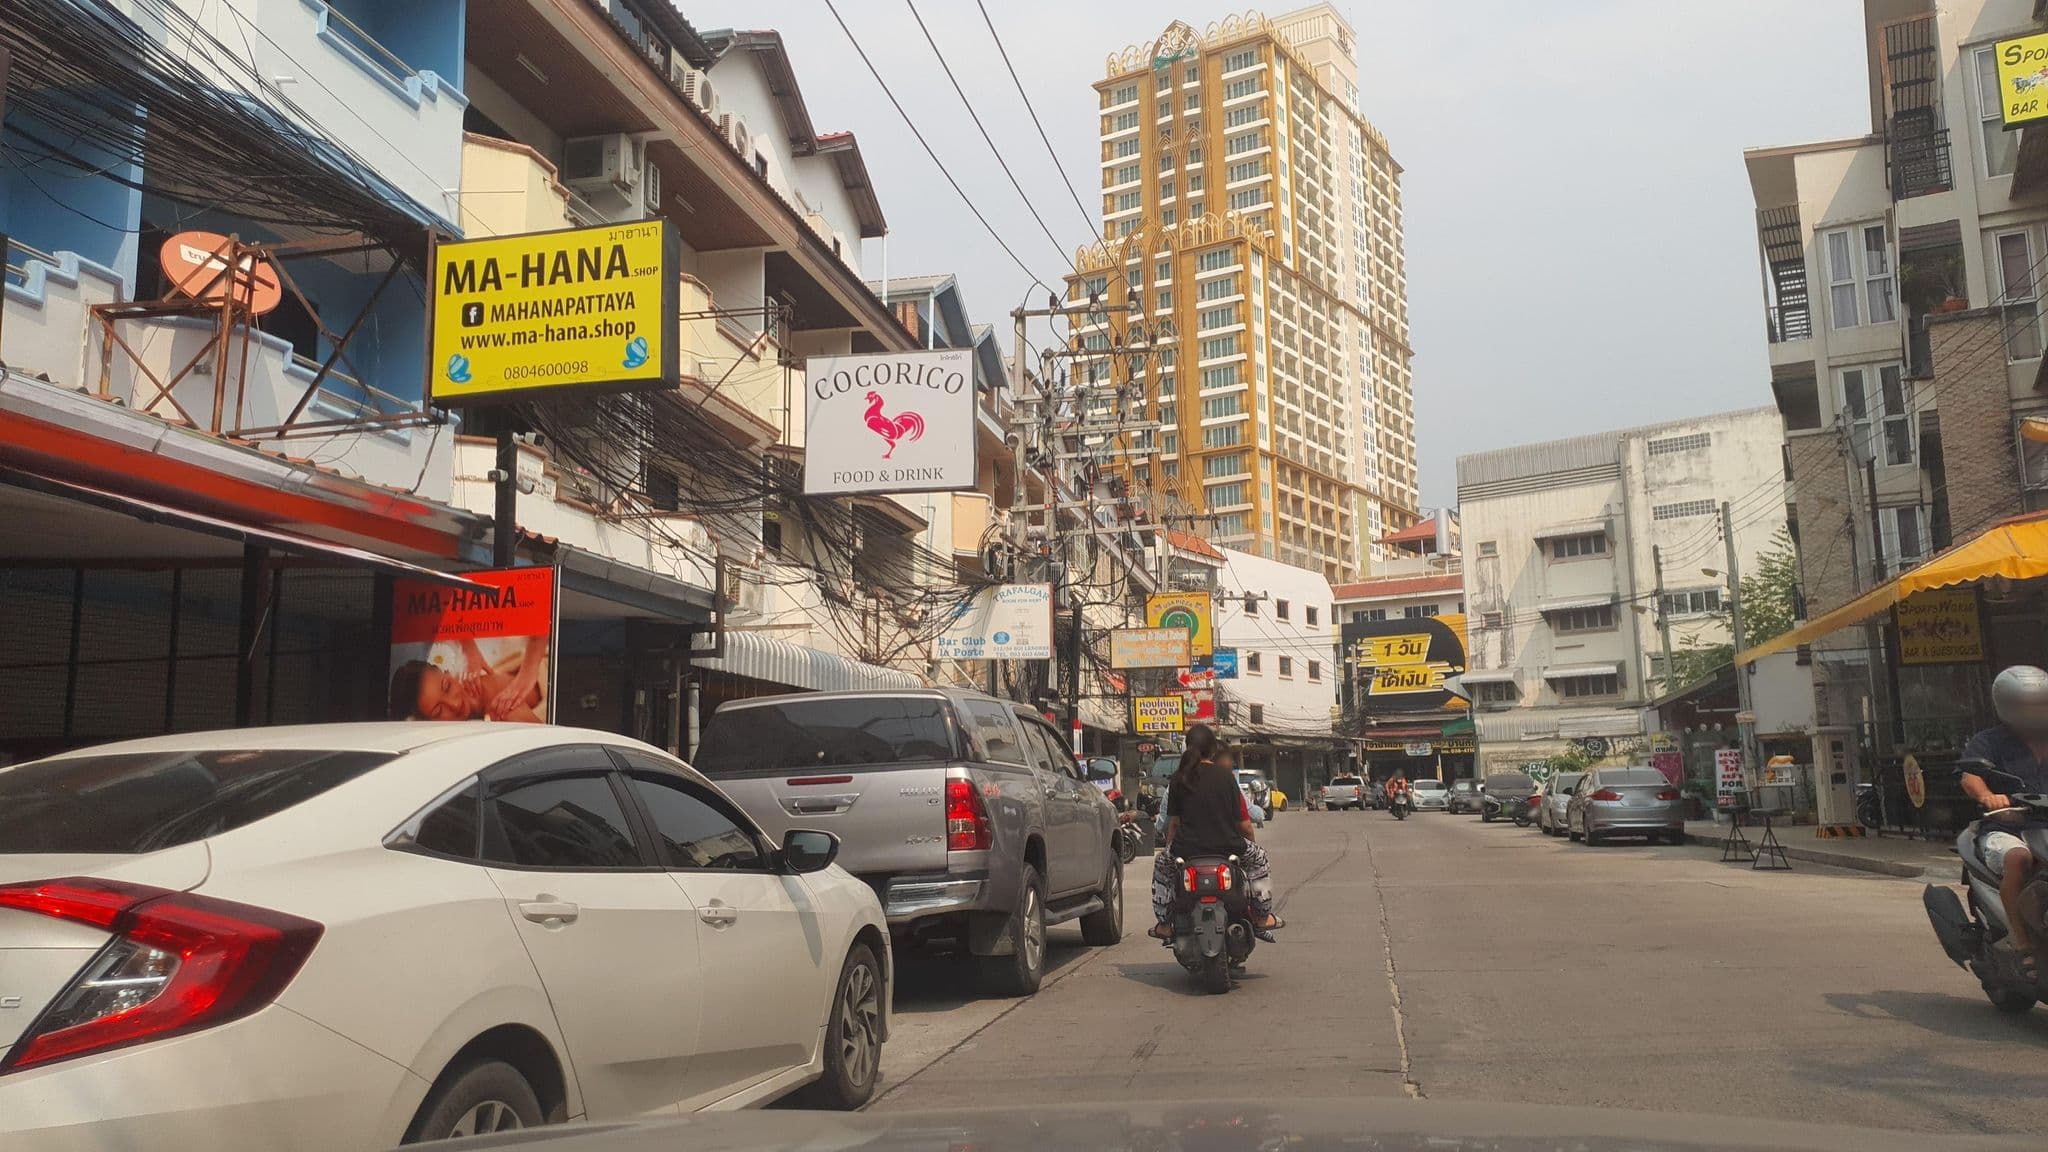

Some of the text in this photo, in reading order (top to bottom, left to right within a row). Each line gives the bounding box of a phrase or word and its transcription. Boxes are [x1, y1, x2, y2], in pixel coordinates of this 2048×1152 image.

[2011, 99, 2038, 116] BAR
[608, 226, 658, 242] มาฮานา
[444, 244, 630, 296] MA-HANA
[490, 291, 636, 323] MAHANAPATTAYA
[460, 319, 636, 350] www.ma-hana.shop
[503, 360, 589, 381] 0804600098
[814, 362, 965, 401] COCORICO
[833, 467, 944, 484] FOOD & DRINK
[407, 586, 517, 614] MA-HANA
[961, 637, 986, 646] Club
[1140, 708, 1179, 716] ROOM
[1142, 722, 1177, 730] RENT
